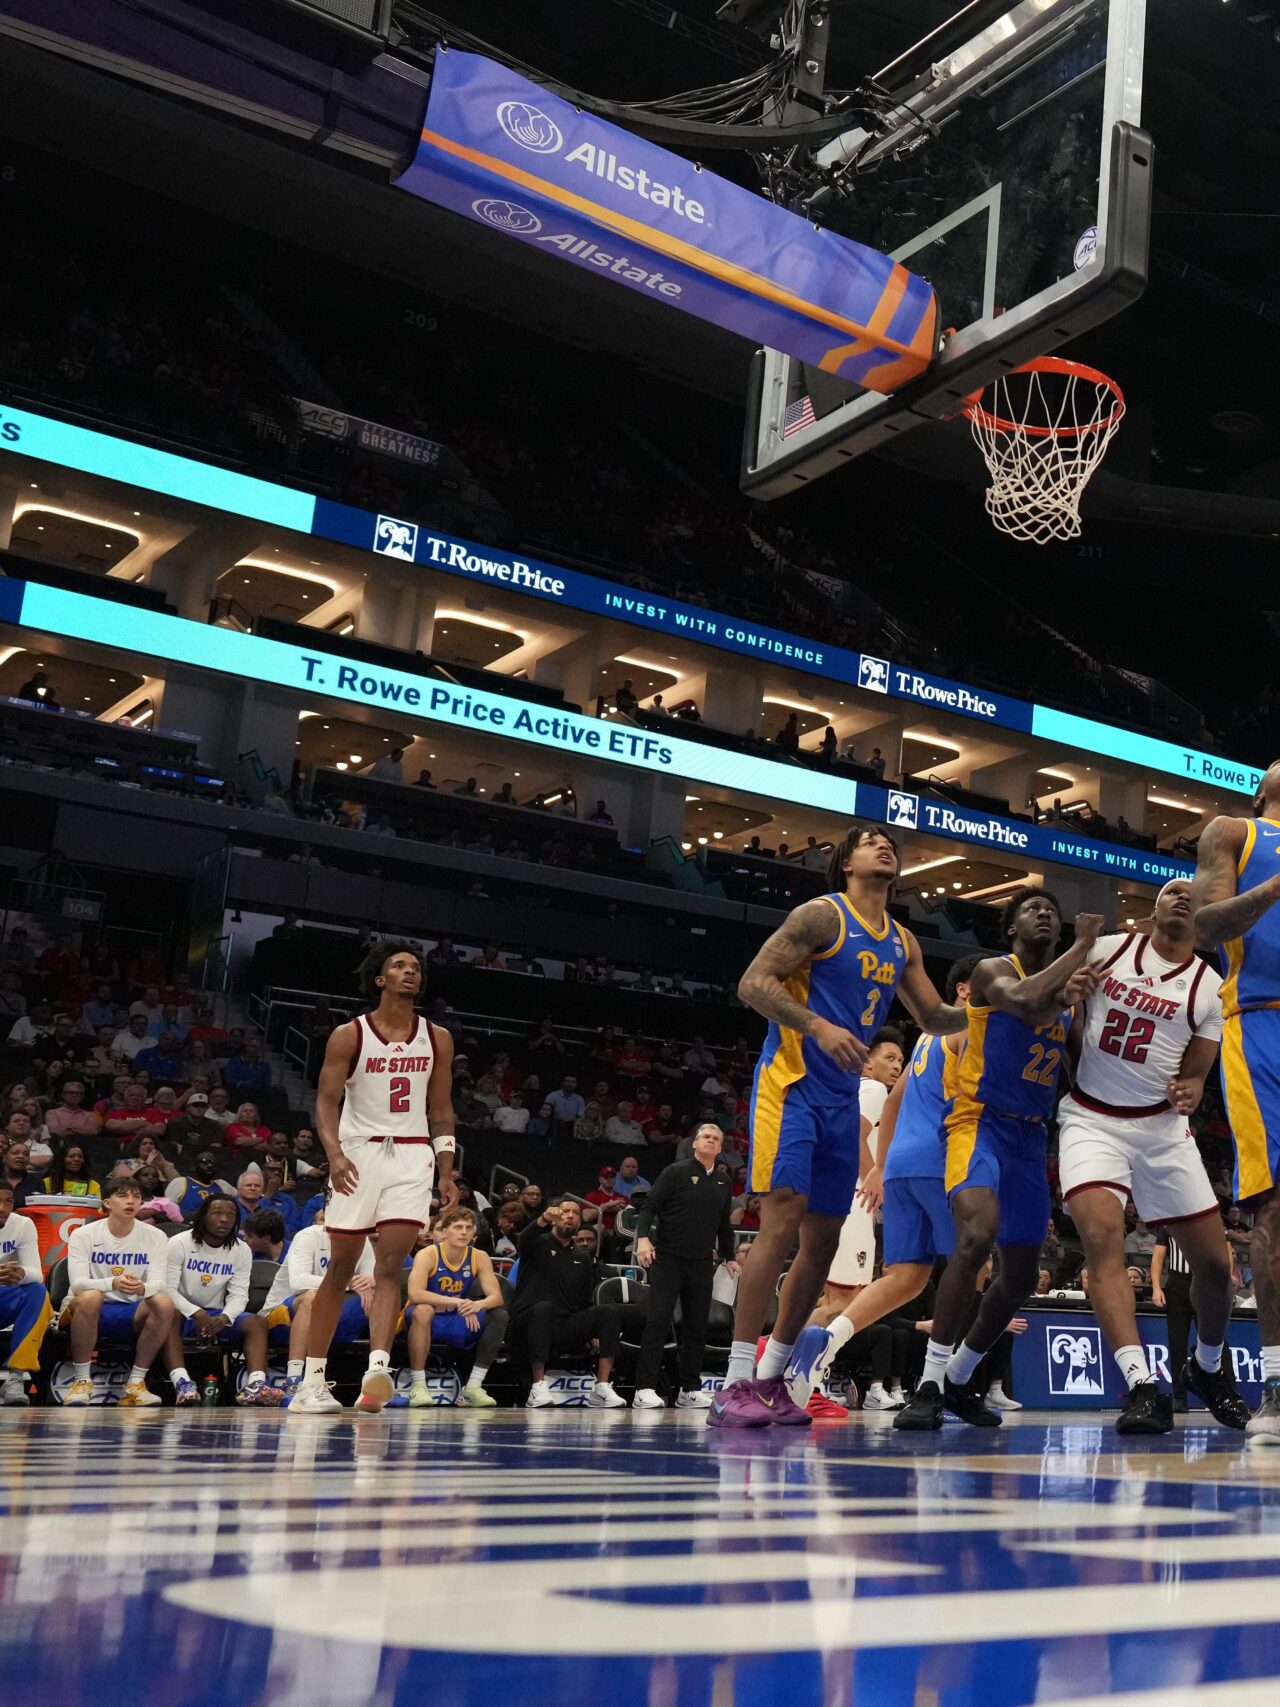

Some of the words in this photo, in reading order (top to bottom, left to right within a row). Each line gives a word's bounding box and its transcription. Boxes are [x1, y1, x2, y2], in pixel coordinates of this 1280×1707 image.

[564, 142, 705, 224] Allstate
[537, 233, 682, 297] Allstate
[1078, 240, 1097, 257] AC
[404, 309, 438, 332] 209
[1077, 545, 1102, 559] 211
[605, 594, 666, 620] INVEST
[676, 613, 717, 635] WITH
[725, 627, 824, 665] CONFIDENCE
[301, 656, 324, 685] T.
[338, 666, 421, 705] Rowe
[430, 687, 505, 726] Price
[513, 709, 601, 748] Active
[609, 732, 673, 765] ETFs
[1183, 754, 1197, 772] T.
[1202, 763, 1245, 786] Rowe
[1052, 841, 1099, 861] INVEST
[1105, 853, 1137, 870] WITH
[1143, 863, 1196, 881] CONFIDE
[68, 902, 93, 916] 104
[857, 950, 897, 985] Pitt
[860, 988, 881, 1026] 2
[1103, 976, 1128, 1002] NC
[1123, 987, 1181, 1021] STATE
[1098, 1007, 1156, 1065] 22
[365, 1057, 387, 1073] NC
[388, 1056, 431, 1073] STATE
[1022, 1042, 1061, 1086] 22
[390, 1076, 411, 1113] 2
[91, 1251, 119, 1265] LOCK
[121, 1252, 133, 1265] IT
[133, 1253, 150, 1265] IN.
[186, 1258, 210, 1273] LOCK
[210, 1262, 220, 1275] IT
[220, 1263, 235, 1276] IN.
[438, 1276, 464, 1292] Pitt
[549, 1377, 595, 1391] ACC
[700, 1379, 723, 1391] AC
